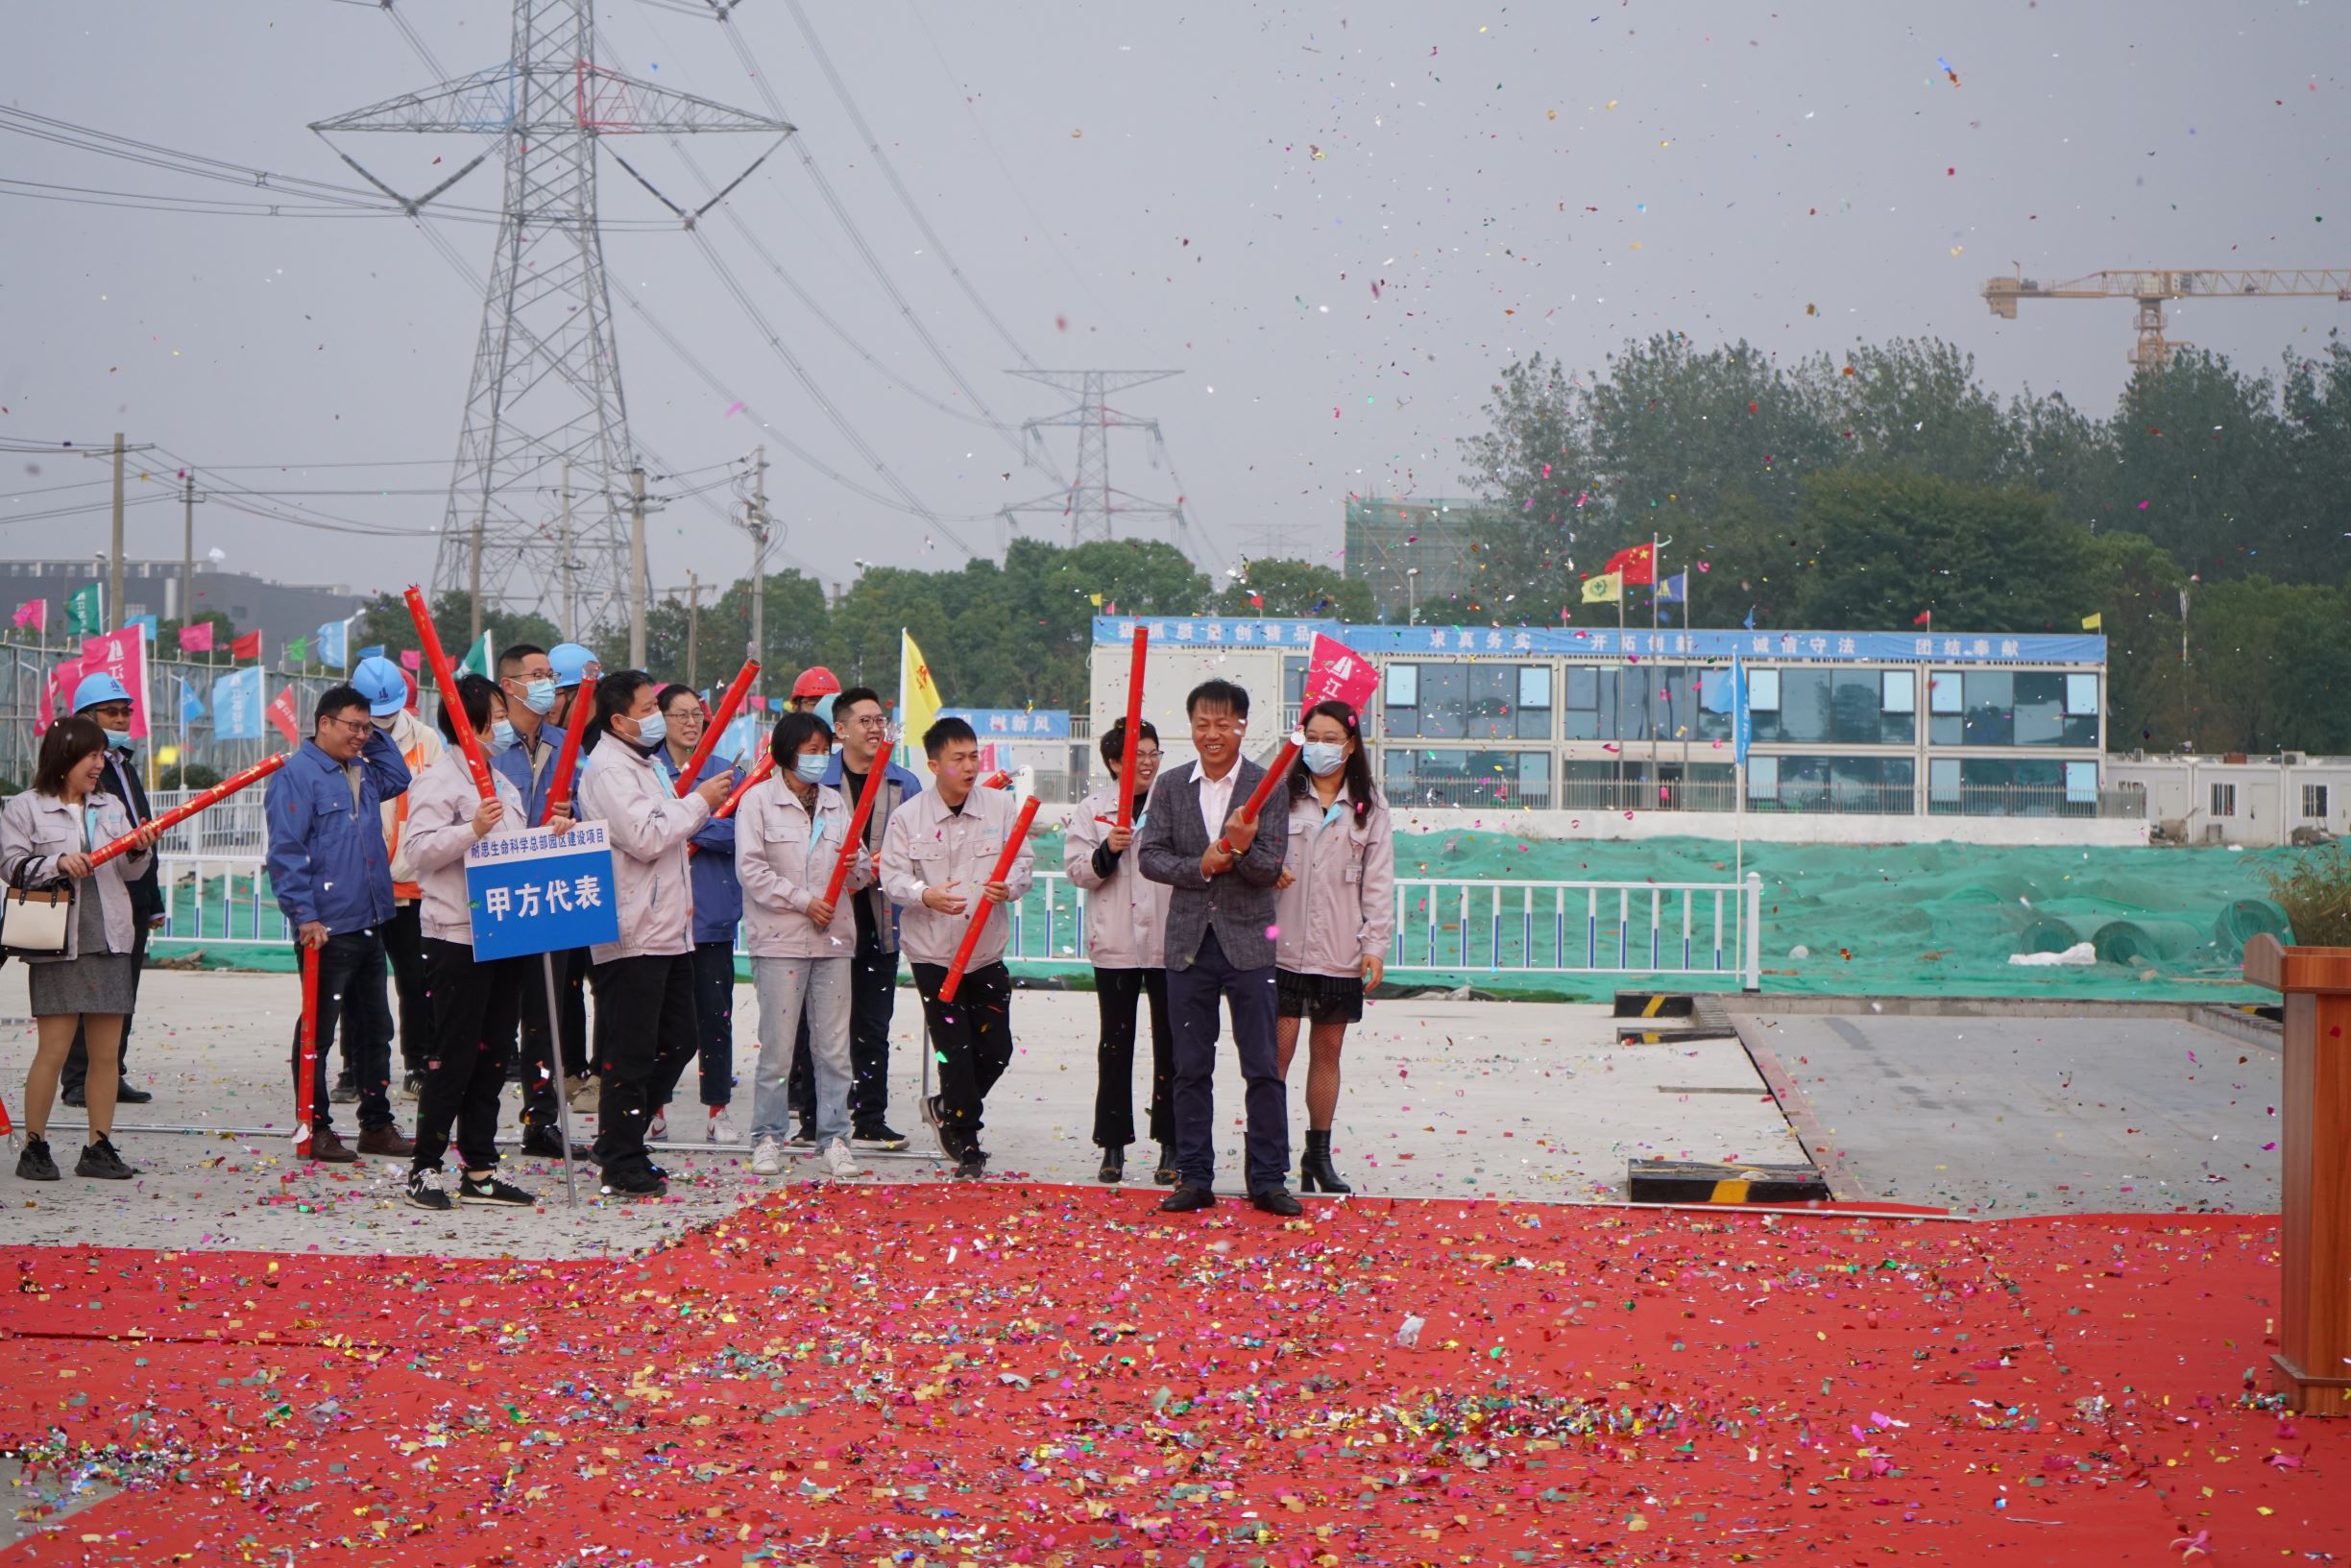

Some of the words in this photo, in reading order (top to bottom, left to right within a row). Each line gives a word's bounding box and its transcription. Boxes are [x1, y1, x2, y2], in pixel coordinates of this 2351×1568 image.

[1430, 631, 1532, 649] 求真务实
[1590, 634, 1694, 653] 开拓创新
[1752, 637, 1855, 655] 诚信守法
[1915, 639, 2020, 657] 团结奉献
[471, 828, 604, 859] 耐思生命科学总部园区建设项目
[485, 875, 602, 922] 甲方代表
